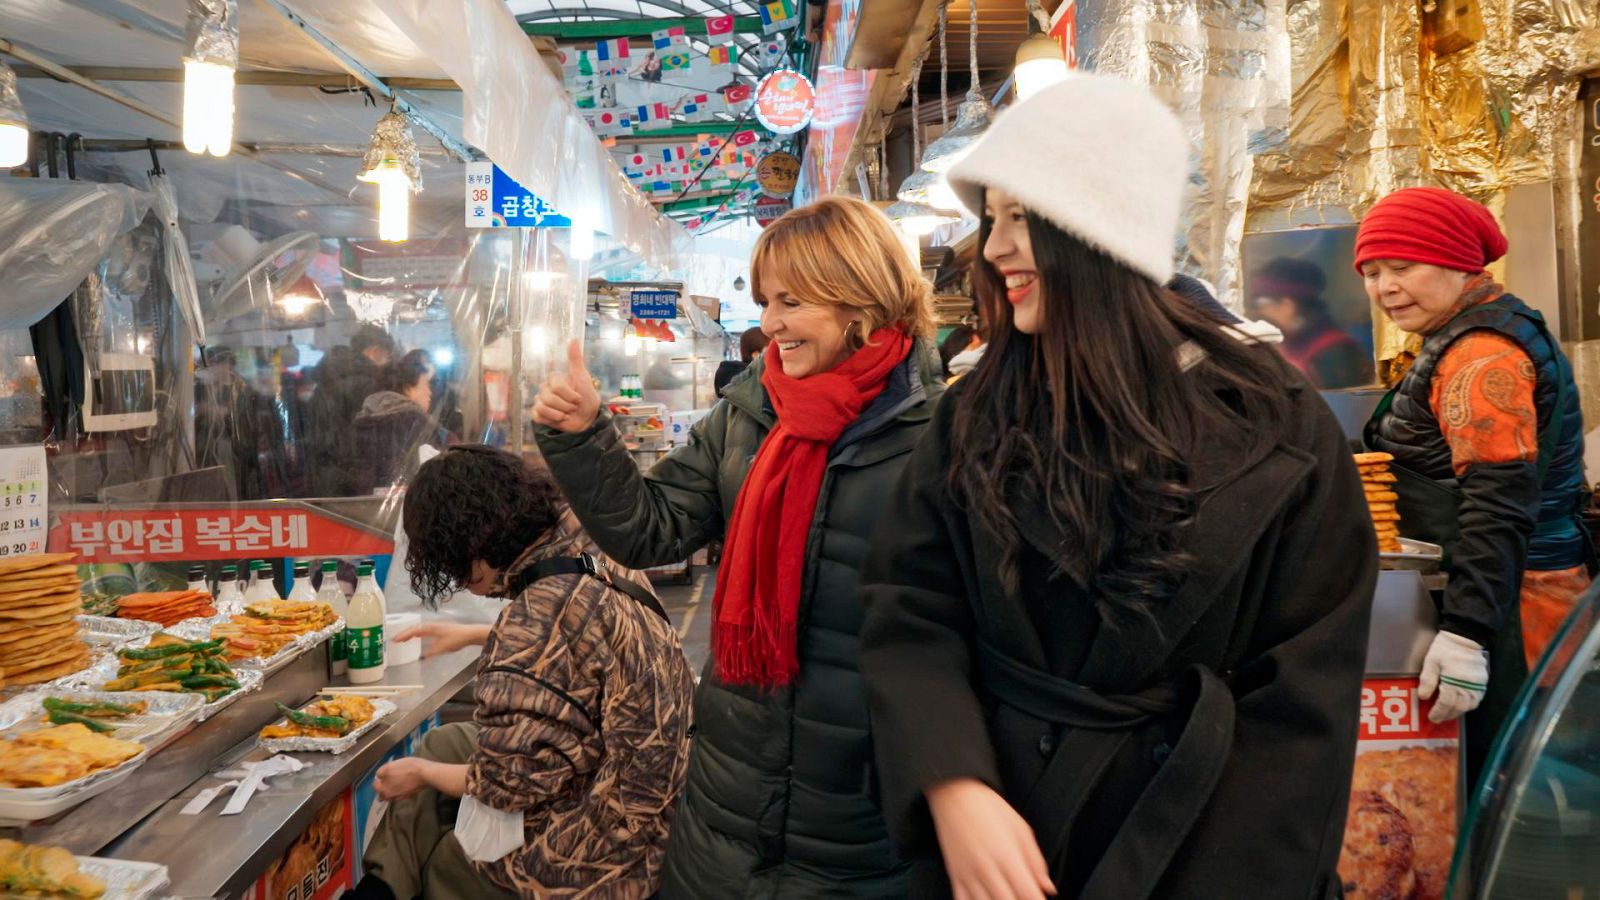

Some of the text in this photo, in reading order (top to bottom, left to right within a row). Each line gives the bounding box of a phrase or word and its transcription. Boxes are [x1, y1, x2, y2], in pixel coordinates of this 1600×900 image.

[467, 174, 491, 184] 동부B
[472, 189, 489, 202] 38
[472, 205, 486, 217] 호
[5, 494, 37, 507] 5 6 7
[0, 517, 39, 532] 12 13 14
[69, 514, 308, 556] 부안집 복순네
[13, 543, 27, 554] 20
[29, 541, 39, 551] 21
